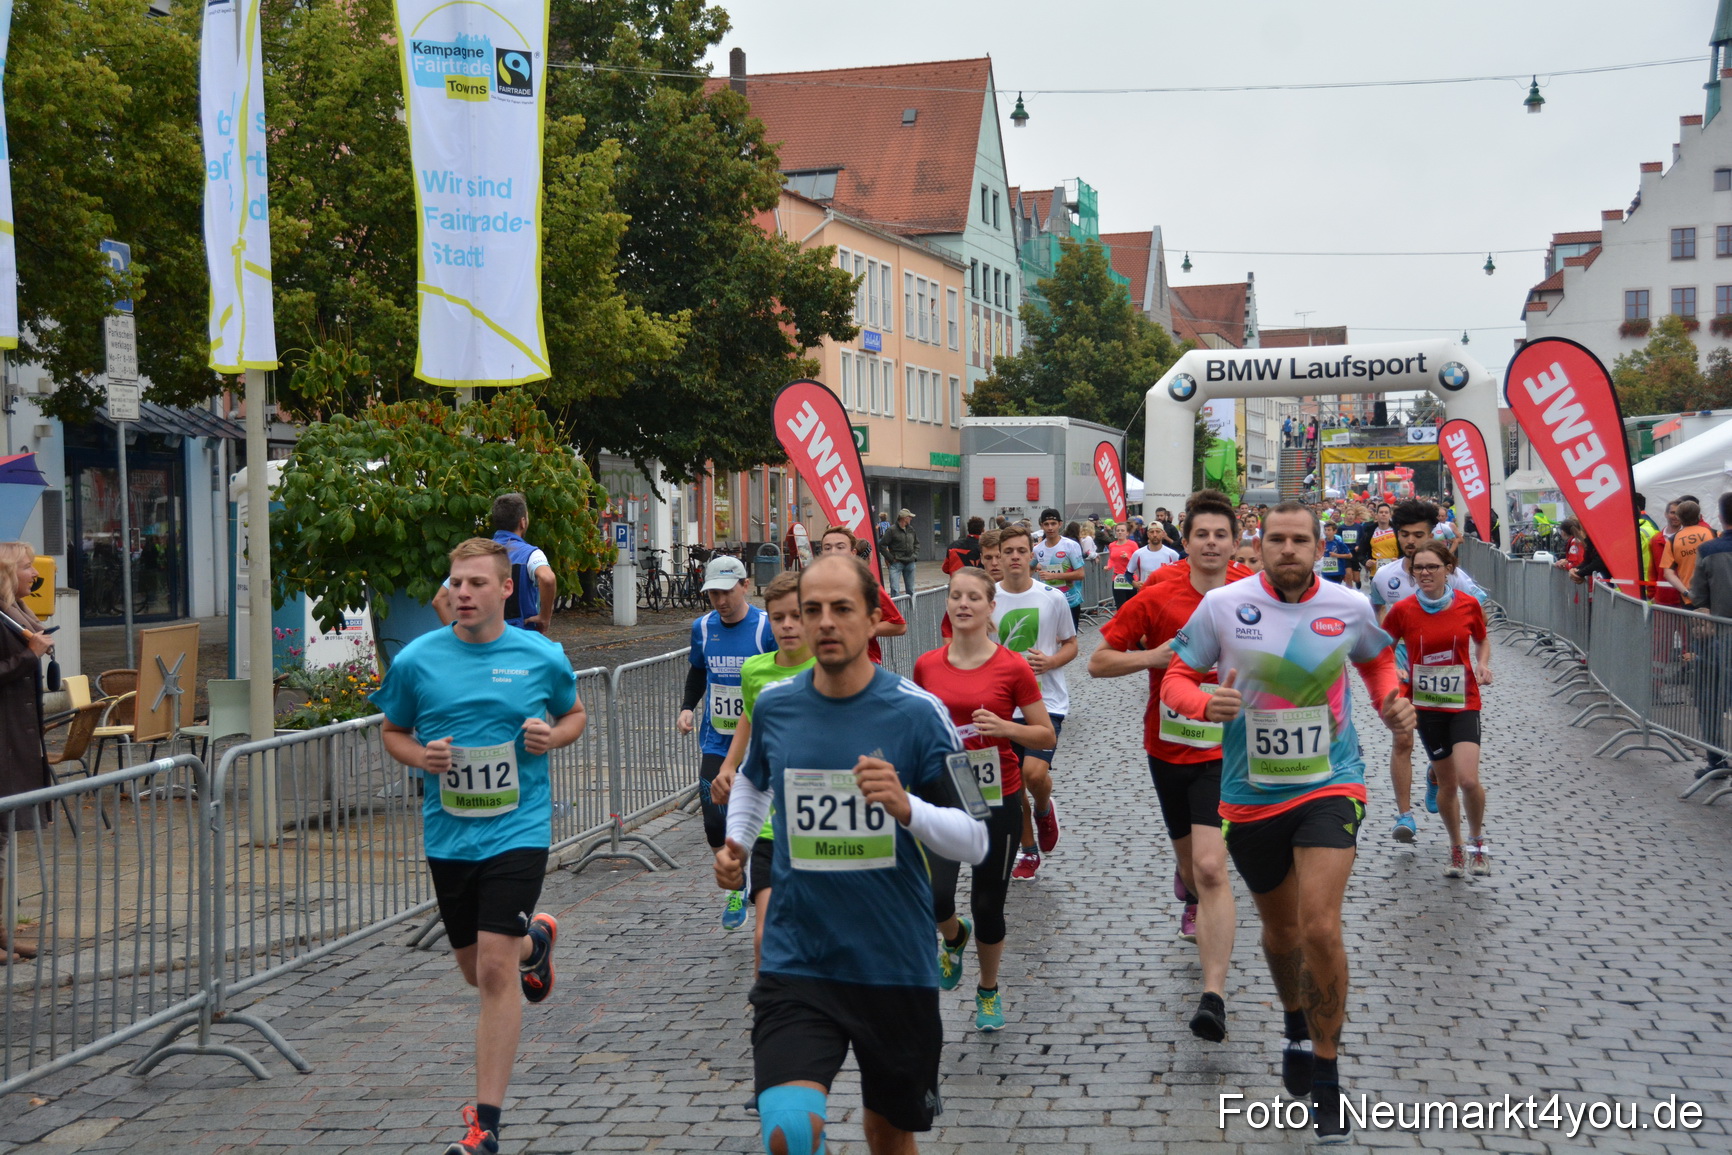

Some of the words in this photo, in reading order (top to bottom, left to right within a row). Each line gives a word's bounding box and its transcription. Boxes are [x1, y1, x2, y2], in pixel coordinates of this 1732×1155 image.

[413, 41, 485, 60] Kampagne
[414, 56, 492, 76] Fairtrade
[447, 79, 487, 95] Towns
[498, 85, 532, 96] FAIRTRADE
[422, 169, 463, 194] Wir
[467, 175, 513, 200] sind
[108, 327, 133, 340] Parkschein
[1206, 358, 1283, 382] BMW
[1290, 352, 1428, 381] Laufsport
[1367, 449, 1394, 460] ZIEL
[1679, 533, 1706, 547] TSV
[1236, 627, 1263, 636] PARTL
[707, 655, 750, 668] HUBE
[1418, 675, 1460, 693] 5197
[1283, 710, 1321, 723] BOCK
[1180, 727, 1205, 739] Josef
[1255, 725, 1322, 756] 5317
[1260, 760, 1311, 773] Alexander
[446, 761, 512, 790] 5112
[456, 796, 502, 807] Matthias
[796, 794, 885, 831] 5216
[815, 841, 865, 856] Marius
